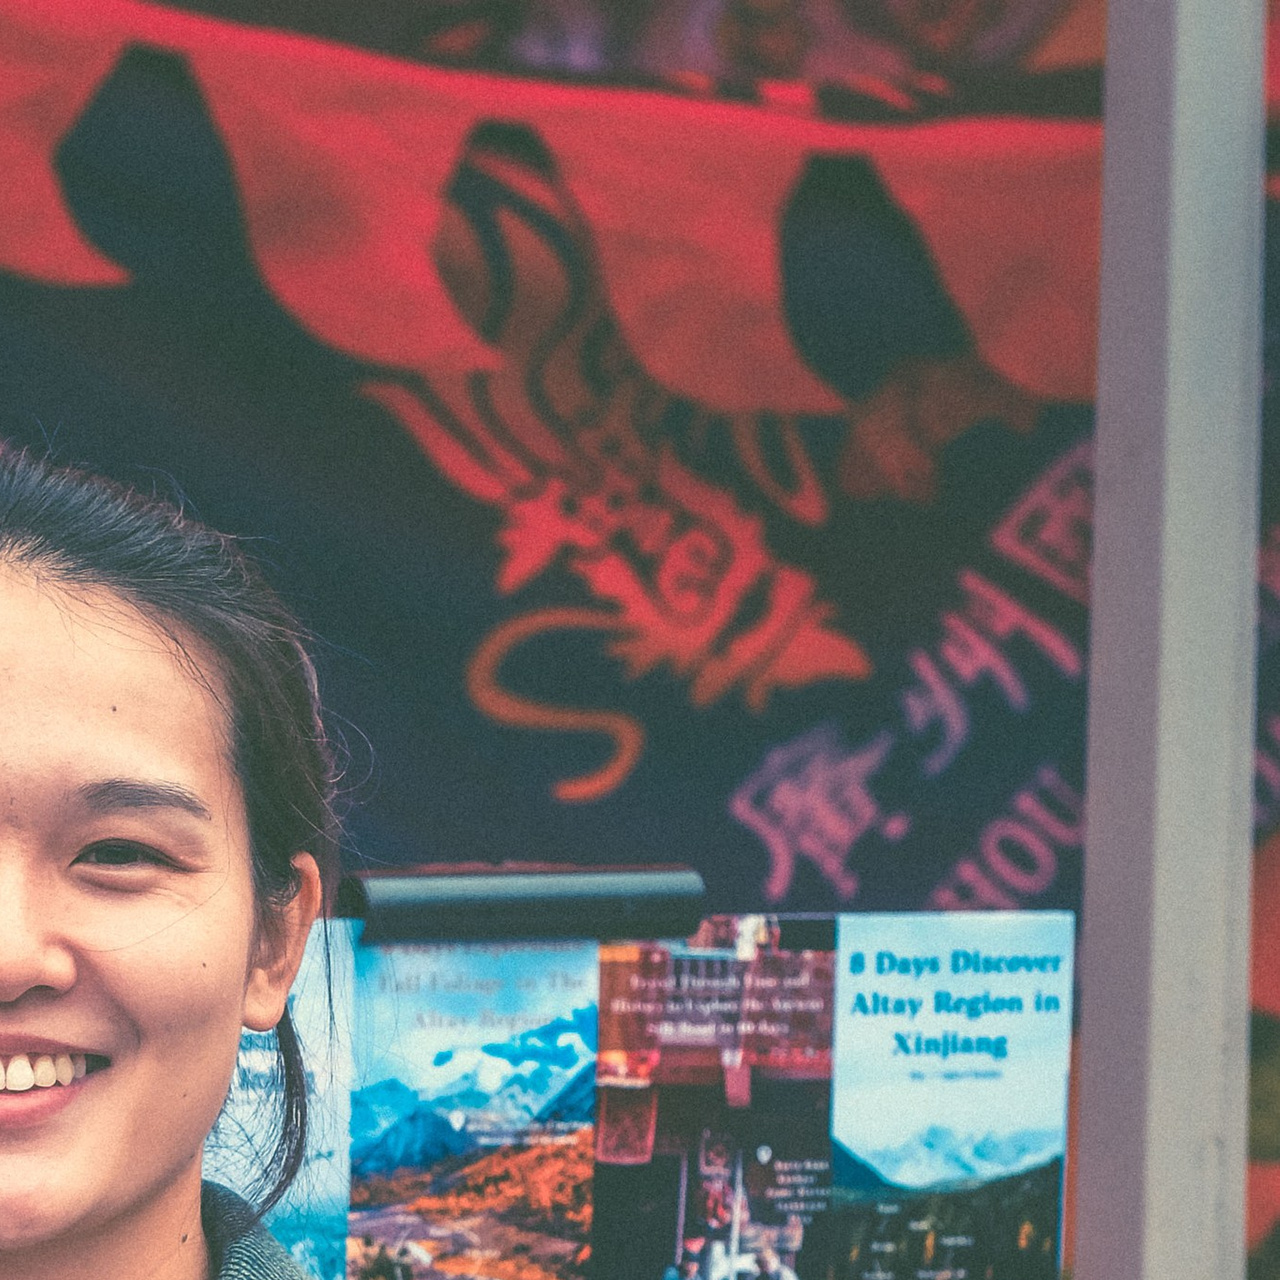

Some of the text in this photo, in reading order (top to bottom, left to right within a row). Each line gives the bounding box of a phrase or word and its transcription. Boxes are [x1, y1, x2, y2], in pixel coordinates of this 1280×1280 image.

[875, 950, 940, 980] Days
[950, 949, 1061, 975] Discover
[851, 989, 1060, 1020] Altay Region in
[892, 1030, 1009, 1061] Xinjiang
